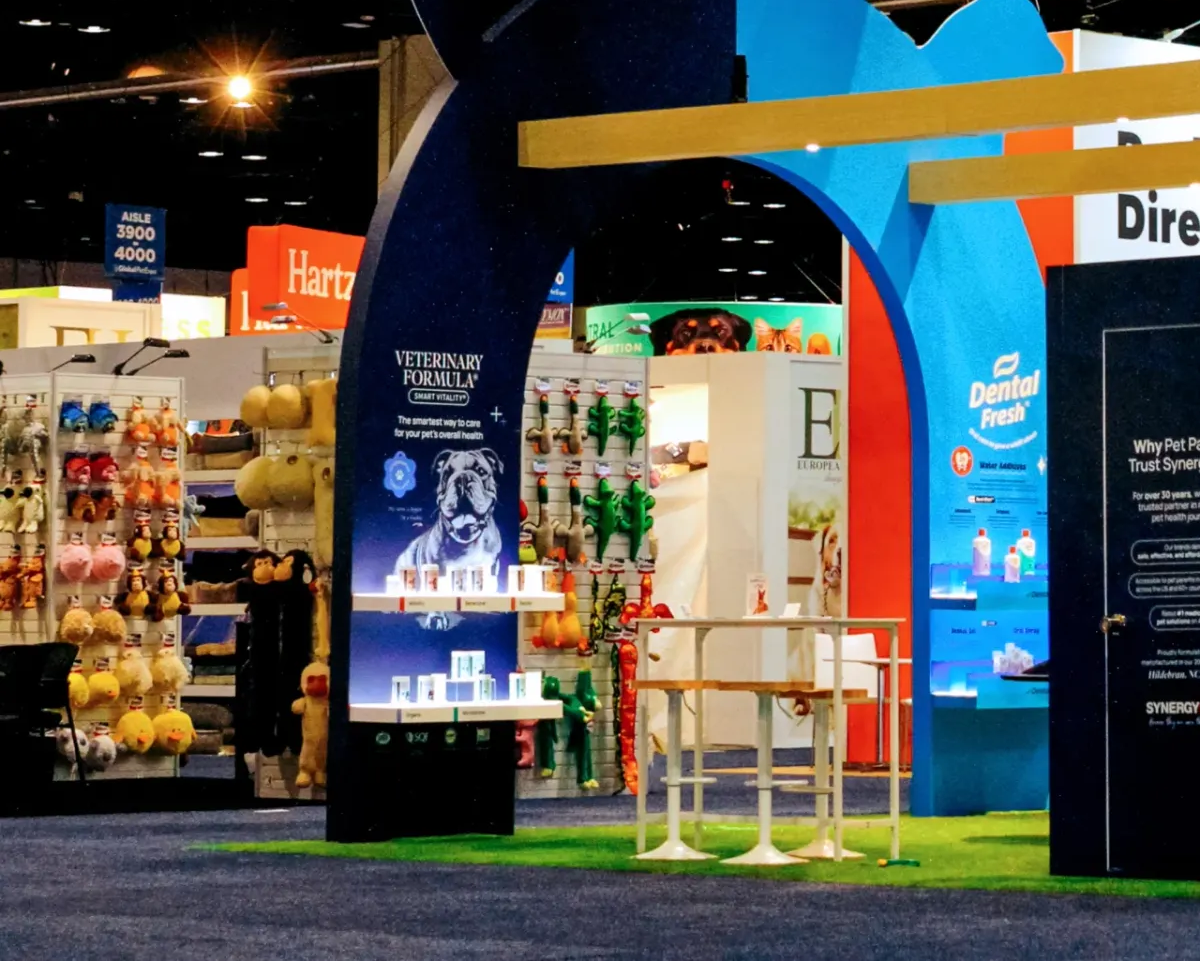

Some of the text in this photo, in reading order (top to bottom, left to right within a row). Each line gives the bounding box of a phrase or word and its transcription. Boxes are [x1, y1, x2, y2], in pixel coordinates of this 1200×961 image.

[121, 211, 152, 224] AISLE
[116, 224, 156, 241] 3900
[114, 246, 156, 262] 4000
[287, 248, 357, 302] Hartz
[395, 350, 483, 370] VETERINARY
[969, 369, 1040, 408] Dental
[414, 392, 435, 400] SMART
[398, 415, 481, 428] The smartest way to care
[394, 428, 404, 437] for
[405, 430, 420, 440] your
[438, 430, 462, 439] overall
[462, 431, 483, 440] health
[1133, 439, 1162, 456] Why
[1164, 438, 1186, 452] Pet
[1128, 458, 1161, 473] Trust
[1132, 491, 1143, 500] For
[1144, 492, 1160, 500] over
[1138, 503, 1163, 512] trusted
[1164, 502, 1189, 511] partner
[1151, 514, 1163, 524] pet
[1164, 513, 1186, 522] health
